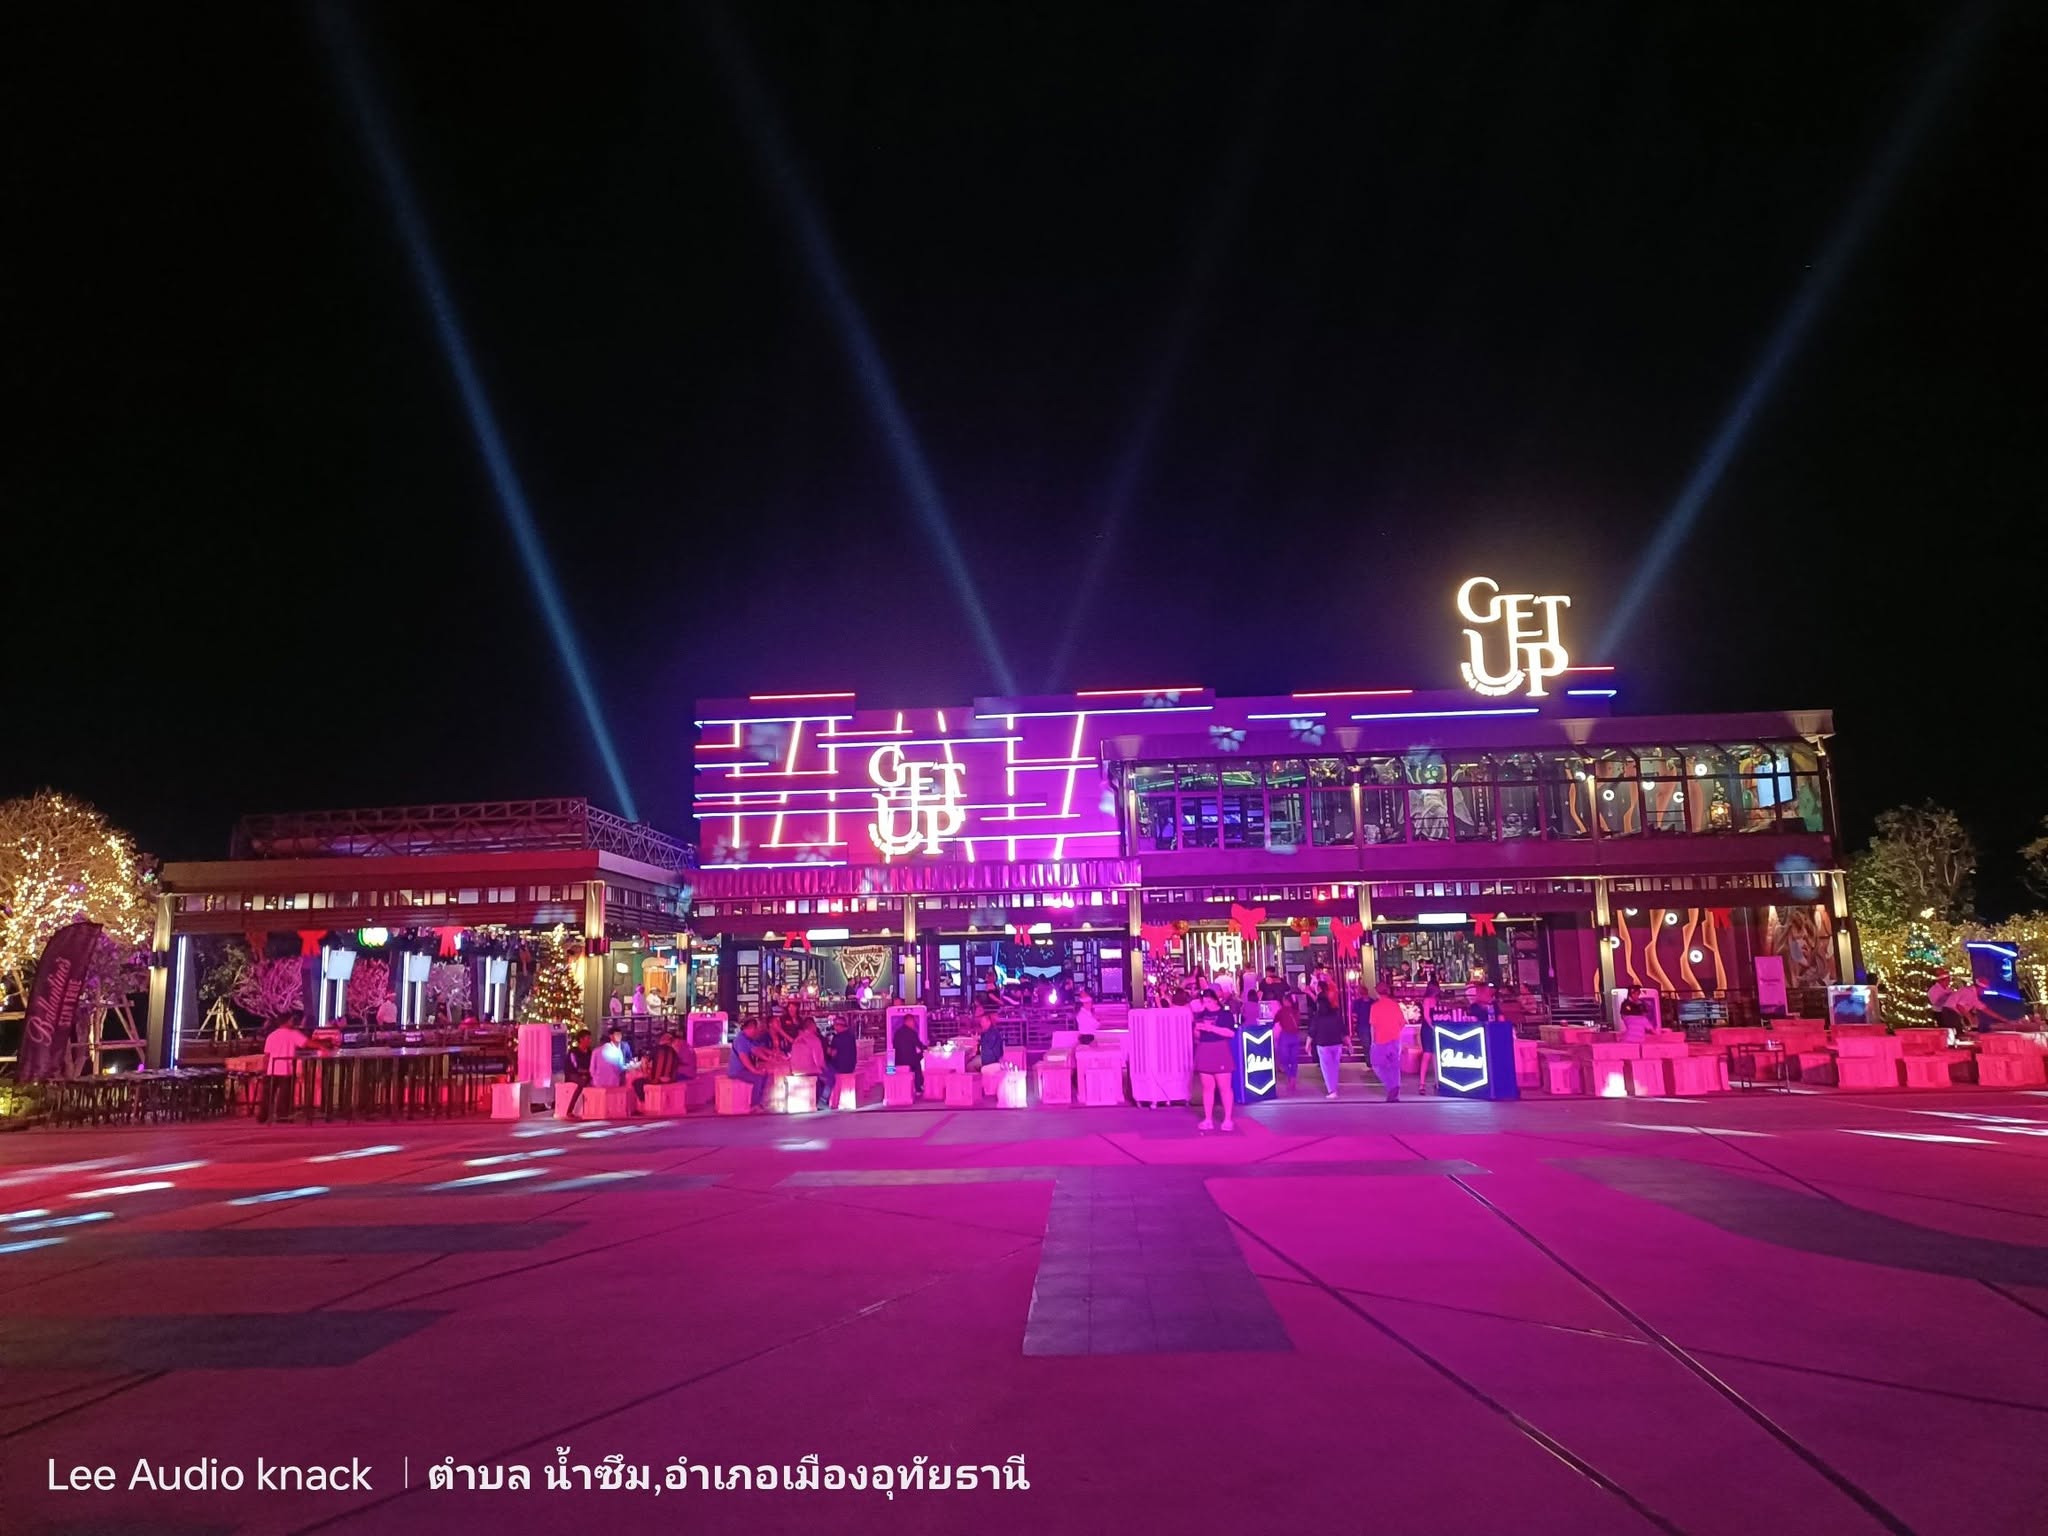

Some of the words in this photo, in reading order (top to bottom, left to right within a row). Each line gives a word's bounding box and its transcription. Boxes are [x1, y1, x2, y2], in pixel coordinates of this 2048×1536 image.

[1457, 577, 1571, 645] GET
[1461, 629, 1569, 697] UP
[869, 745, 966, 803] GET
[870, 793, 967, 855] UP
[28, 956, 72, 1047] Ballantine's
[59, 1004, 74, 1027] STAY
[63, 979, 82, 1003] TRUE
